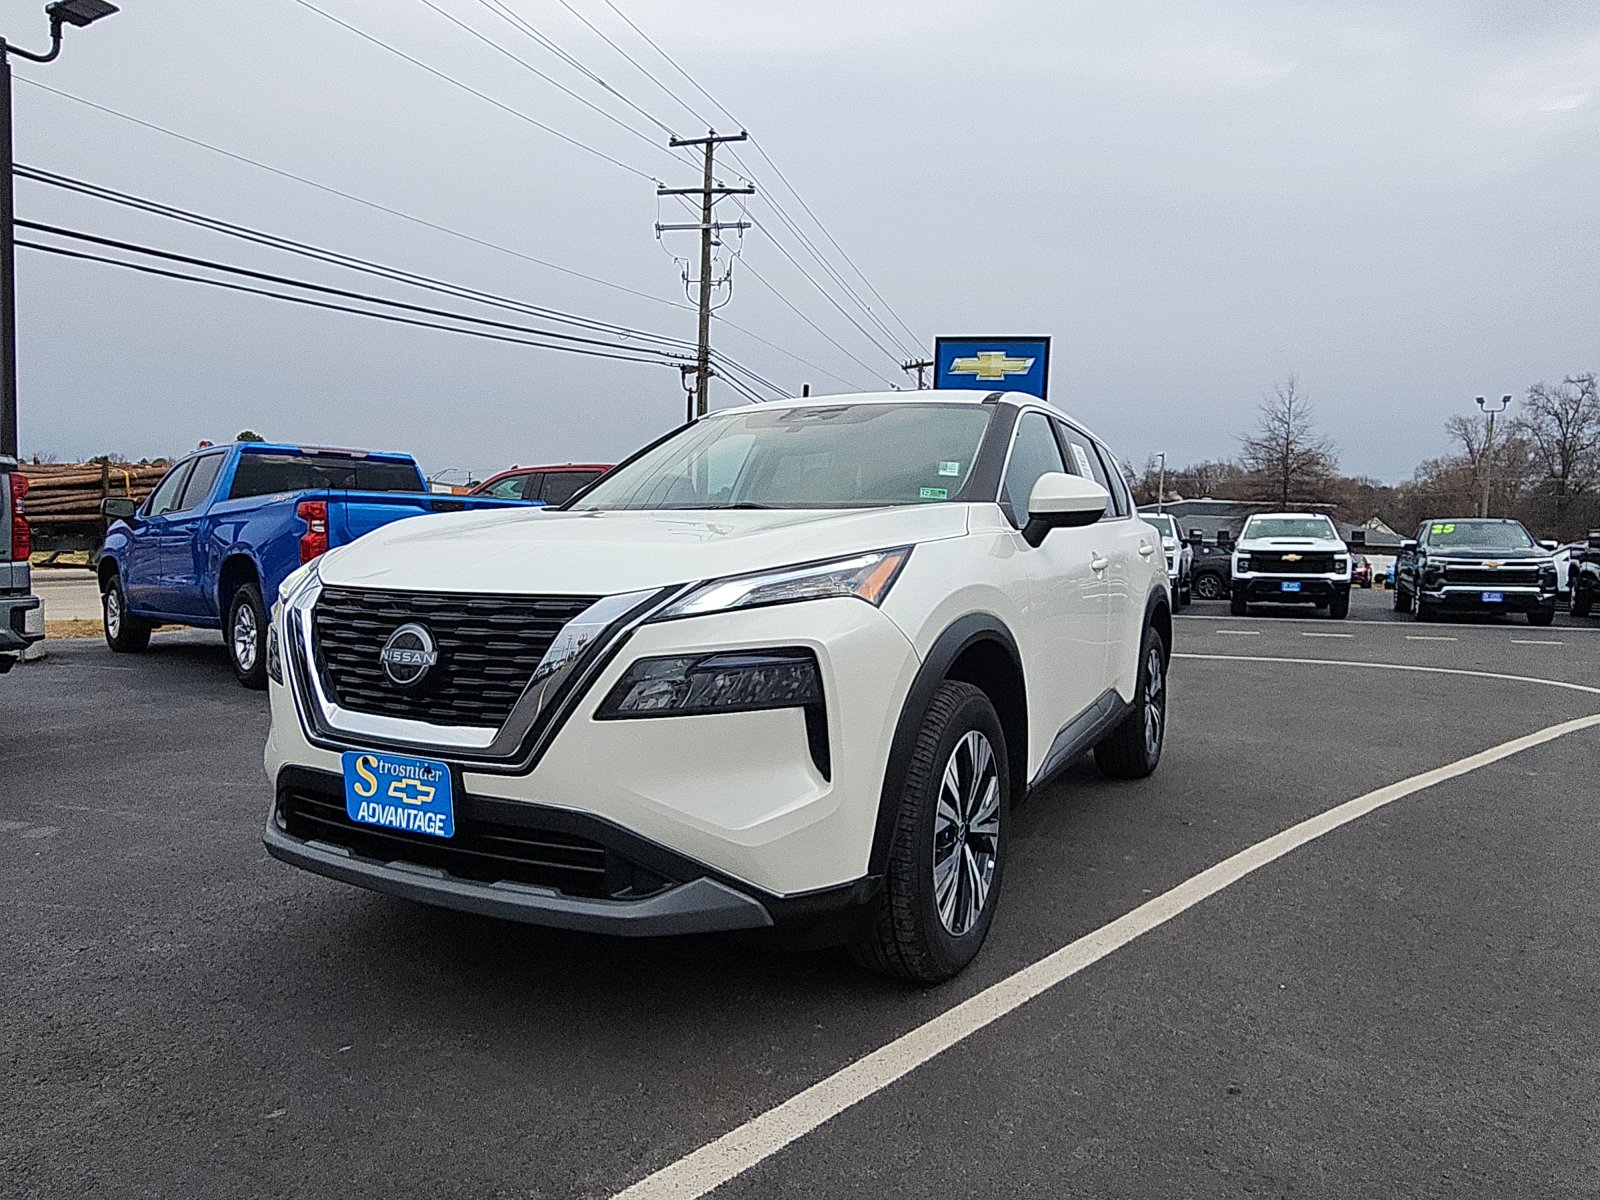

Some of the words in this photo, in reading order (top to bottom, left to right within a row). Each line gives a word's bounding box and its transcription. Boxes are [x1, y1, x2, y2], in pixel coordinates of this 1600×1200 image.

[380, 649, 435, 664] NISSAN
[354, 755, 442, 797] Strosnider
[357, 801, 446, 836] ADVANTAGE
